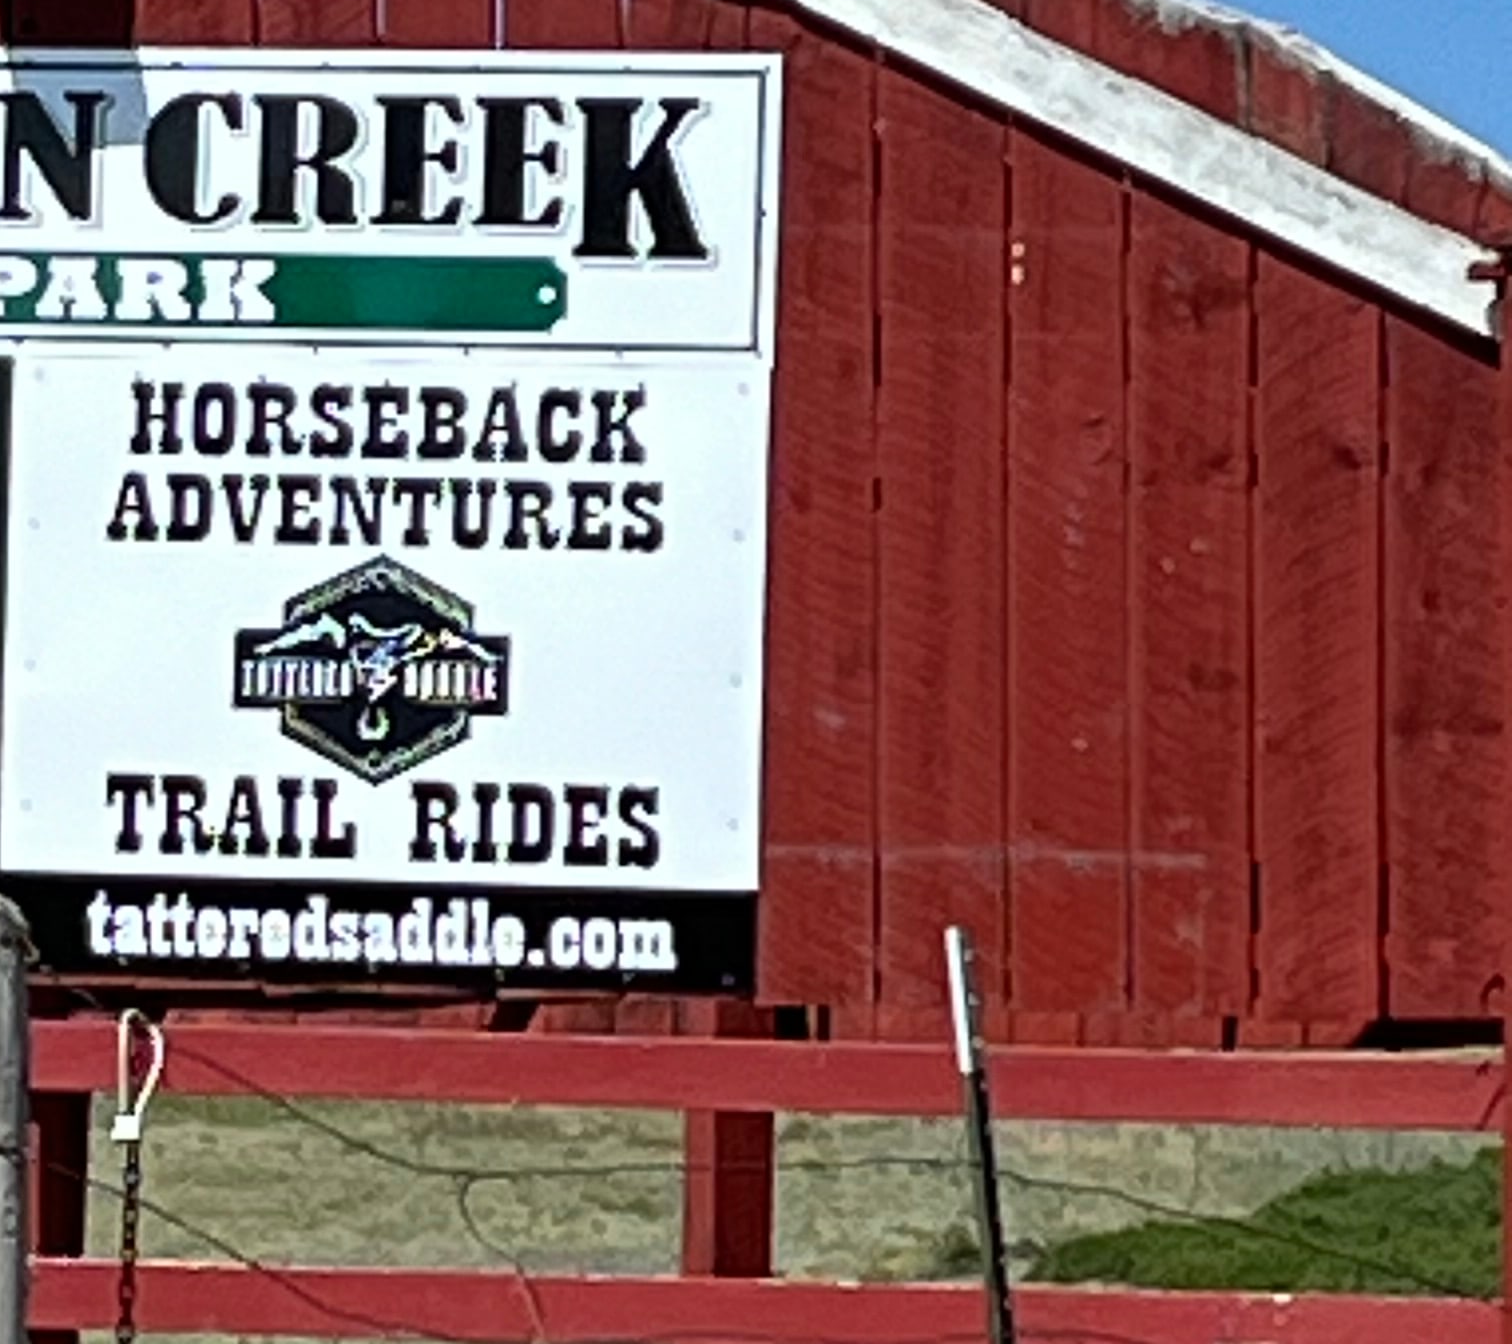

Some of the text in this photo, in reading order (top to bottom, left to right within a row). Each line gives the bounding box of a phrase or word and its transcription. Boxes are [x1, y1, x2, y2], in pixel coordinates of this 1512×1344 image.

[144, 92, 710, 260] CREEK
[128, 380, 647, 464] HORSEBACK
[106, 472, 665, 553] ADVENTURES
[106, 772, 661, 869] TRAIL RIDES
[87, 892, 678, 971] tatteredsaddle.com
